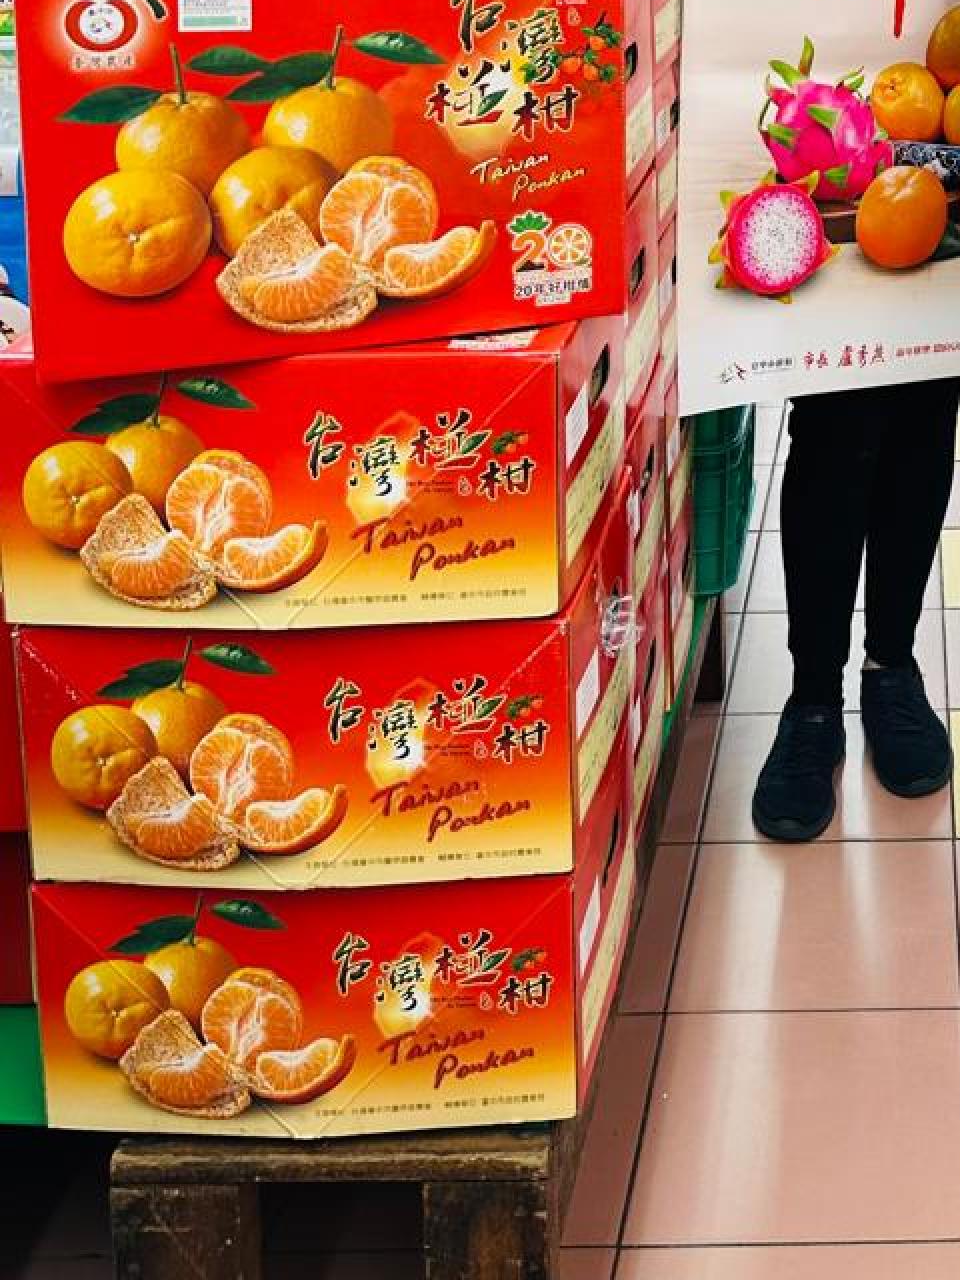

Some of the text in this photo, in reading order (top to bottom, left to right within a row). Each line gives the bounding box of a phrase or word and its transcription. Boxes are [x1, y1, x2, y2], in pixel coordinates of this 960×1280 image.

[469, 153, 549, 184] Taiwan
[511, 168, 586, 203] Ponkan
[351, 516, 463, 554] Taiwan
[410, 537, 515, 581] Ponkan
[369, 780, 479, 816] Taiwan
[427, 799, 530, 842] Ponkan
[377, 1028, 485, 1065] Taiwan
[434, 1047, 535, 1089] Ponkan
